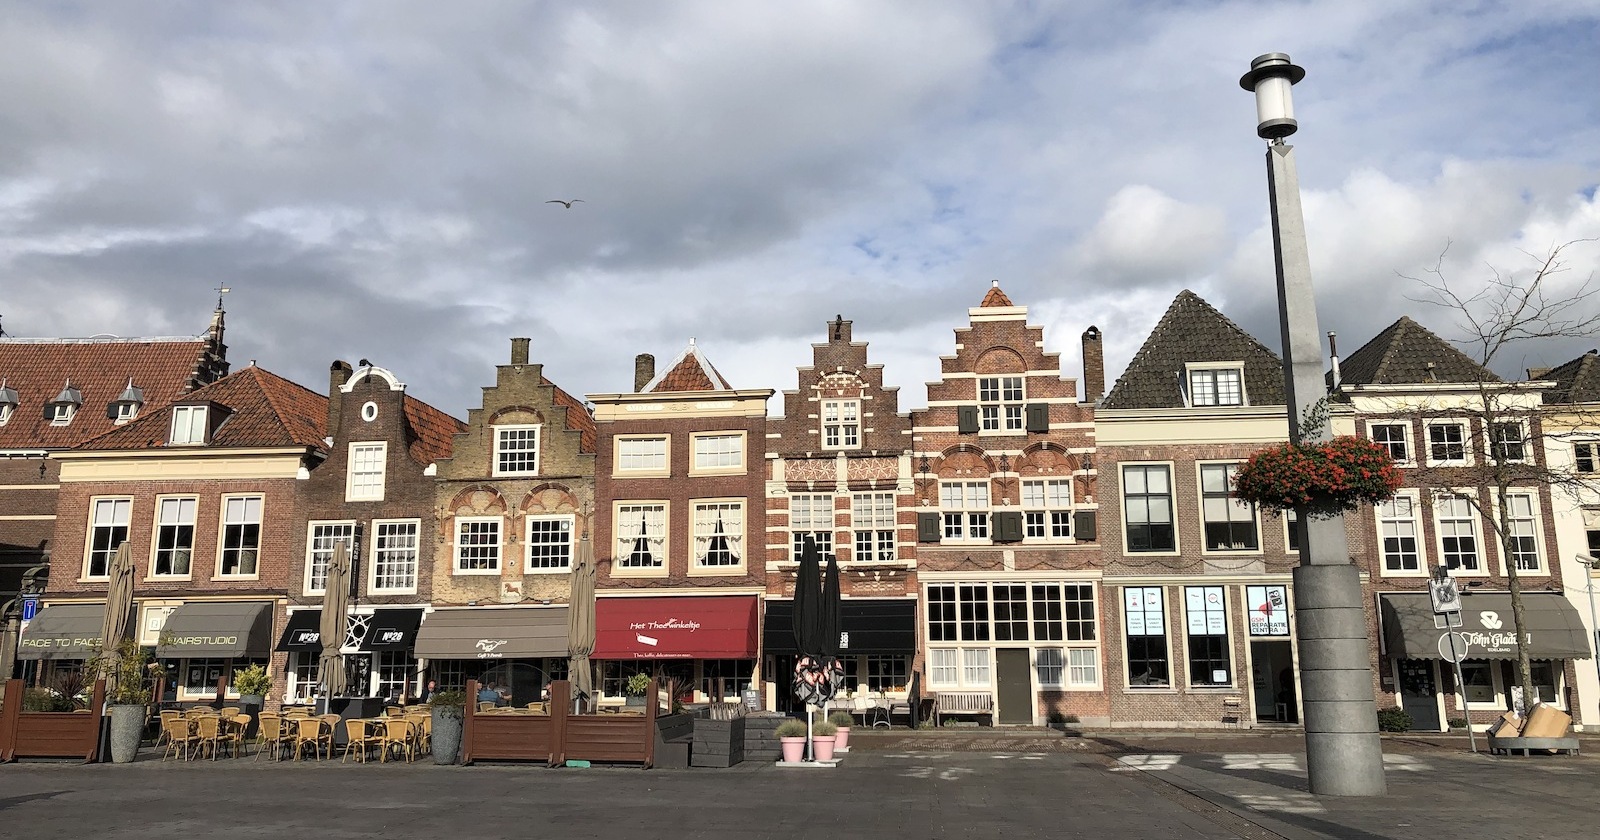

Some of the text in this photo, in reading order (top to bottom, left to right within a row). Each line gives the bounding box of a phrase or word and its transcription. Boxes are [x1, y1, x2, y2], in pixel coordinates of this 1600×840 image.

[630, 622, 646, 630] Het
[22, 637, 103, 648] FACE TO FACE
[1461, 631, 1490, 648] John
